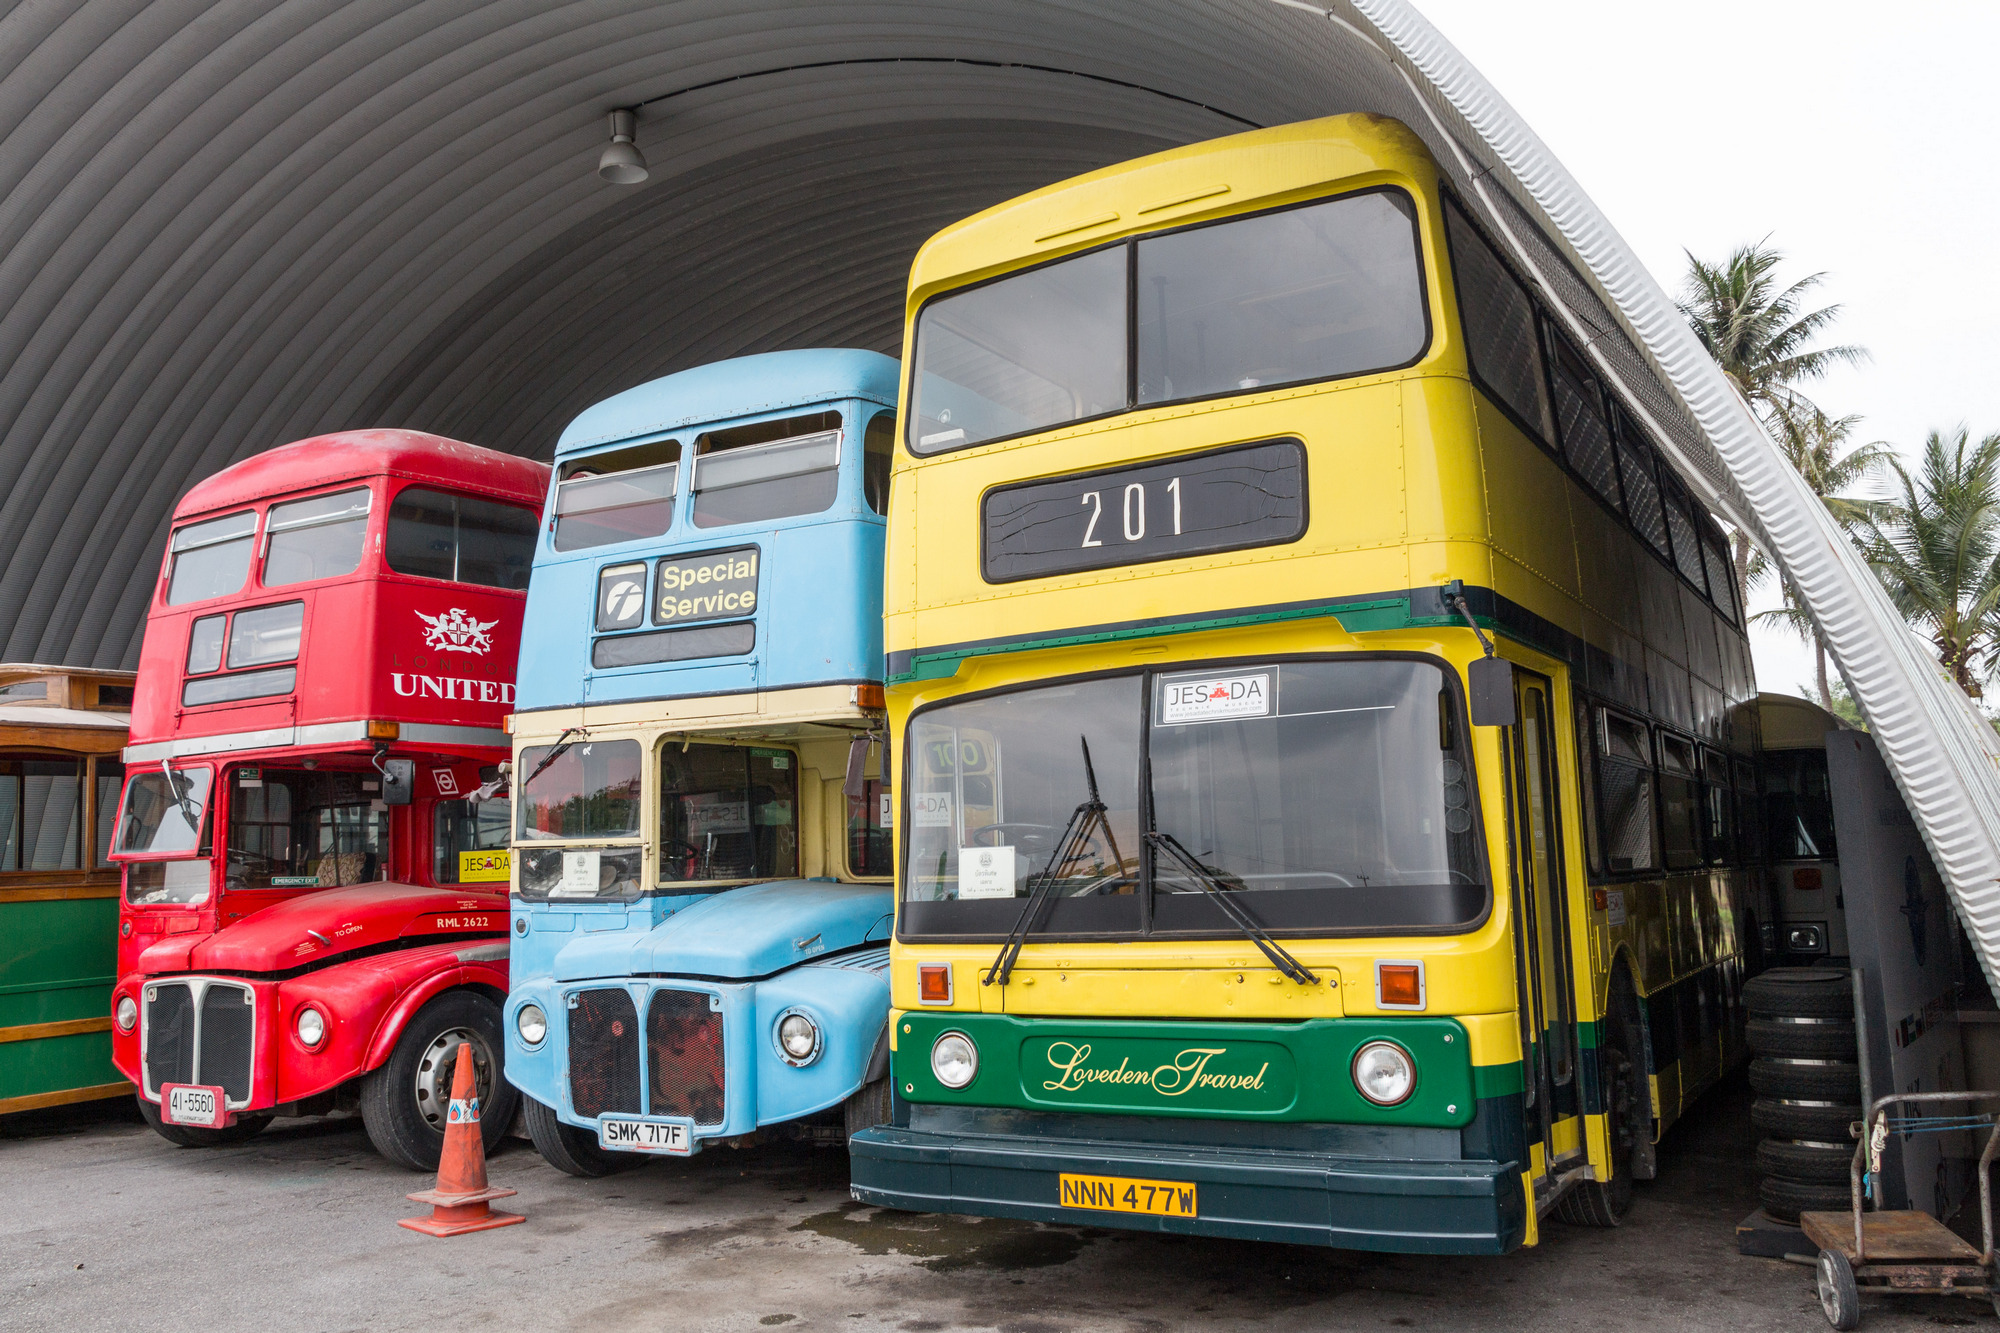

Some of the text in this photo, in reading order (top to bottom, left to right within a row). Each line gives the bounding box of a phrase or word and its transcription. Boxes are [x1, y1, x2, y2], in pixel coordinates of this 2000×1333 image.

[1082, 477, 1182, 548] 201
[664, 554, 757, 591] Special
[660, 589, 755, 619] Service
[393, 654, 517, 676] LONDON
[390, 672, 517, 704] UNITED
[346, 925, 362, 933] OPEN
[436, 917, 489, 928] RML 2622
[1043, 1041, 1269, 1096] Loveden Travel
[171, 1092, 214, 1113] 41-5560
[607, 1123, 682, 1144] SMK 717F
[1063, 1179, 1194, 1214] NNN 477W
